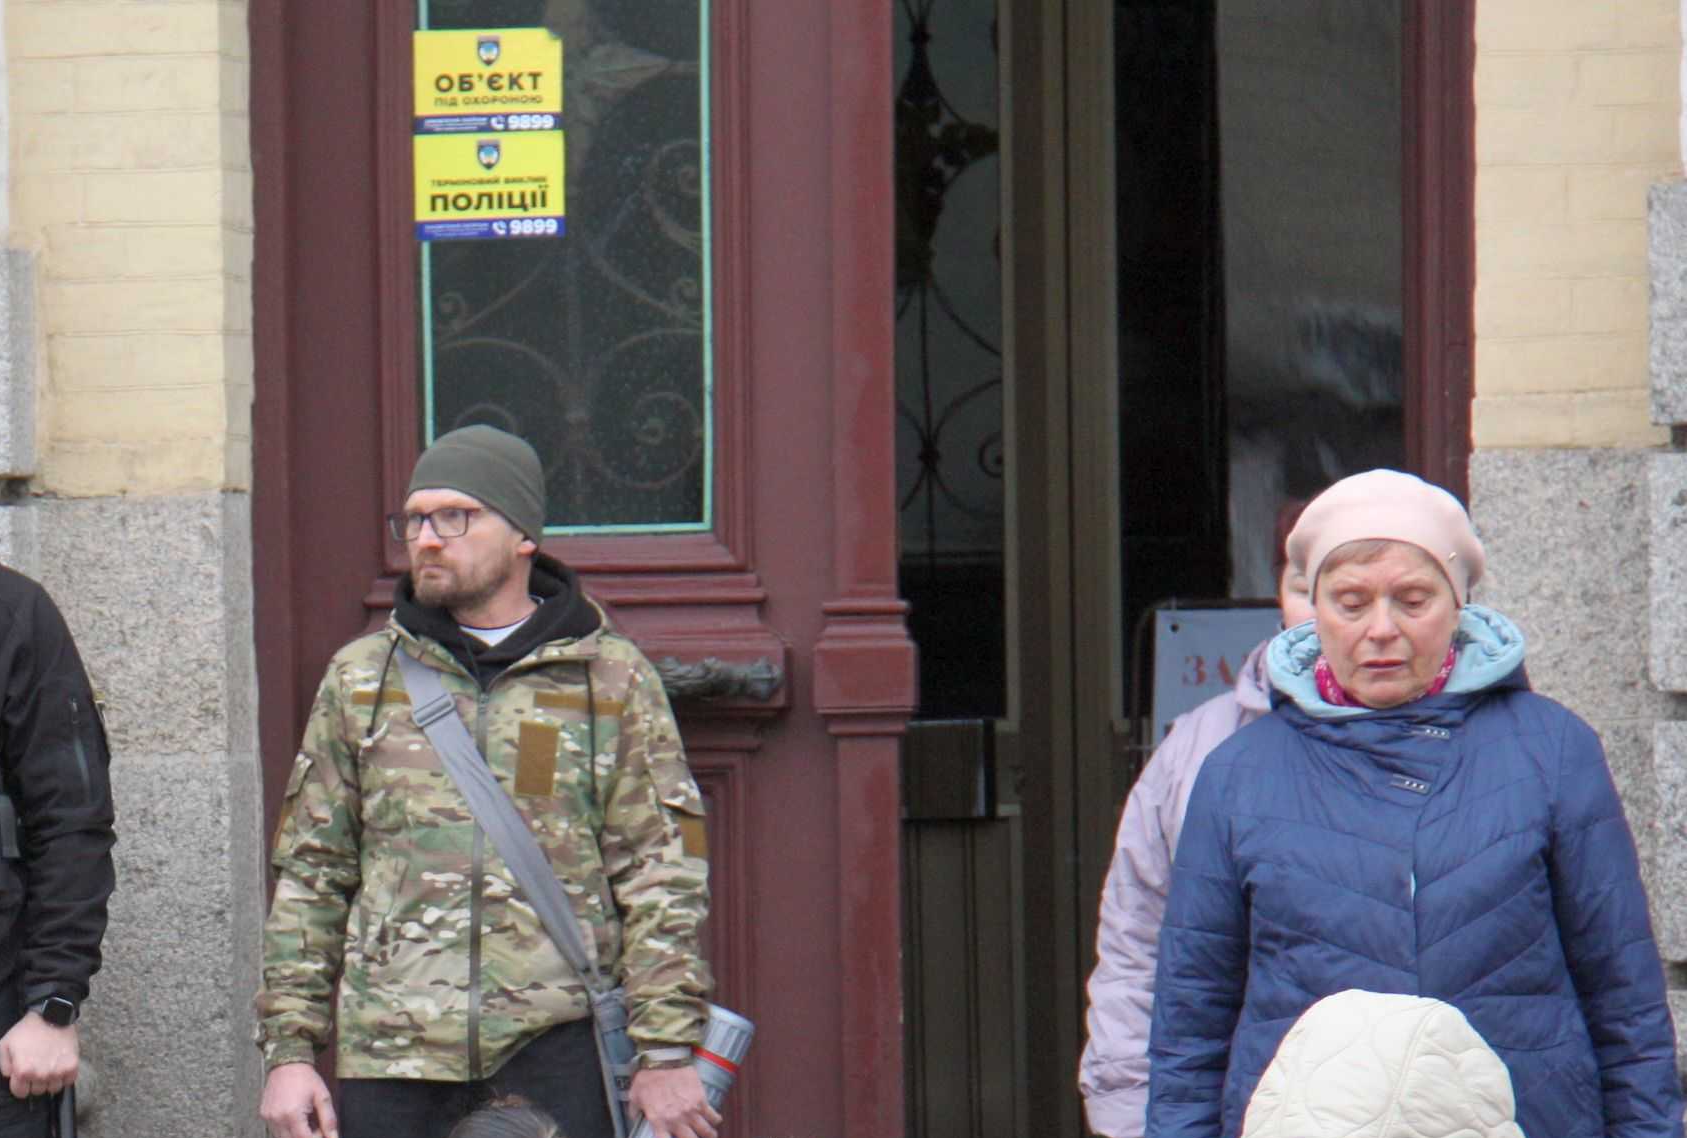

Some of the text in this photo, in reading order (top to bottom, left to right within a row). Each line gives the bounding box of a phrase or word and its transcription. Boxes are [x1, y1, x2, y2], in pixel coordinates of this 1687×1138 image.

[462, 94, 543, 106] ОХОРОНОЮ
[507, 114, 554, 129] 9899
[430, 184, 549, 212] ПОЛІЦІЇ
[509, 218, 558, 235] 9899
